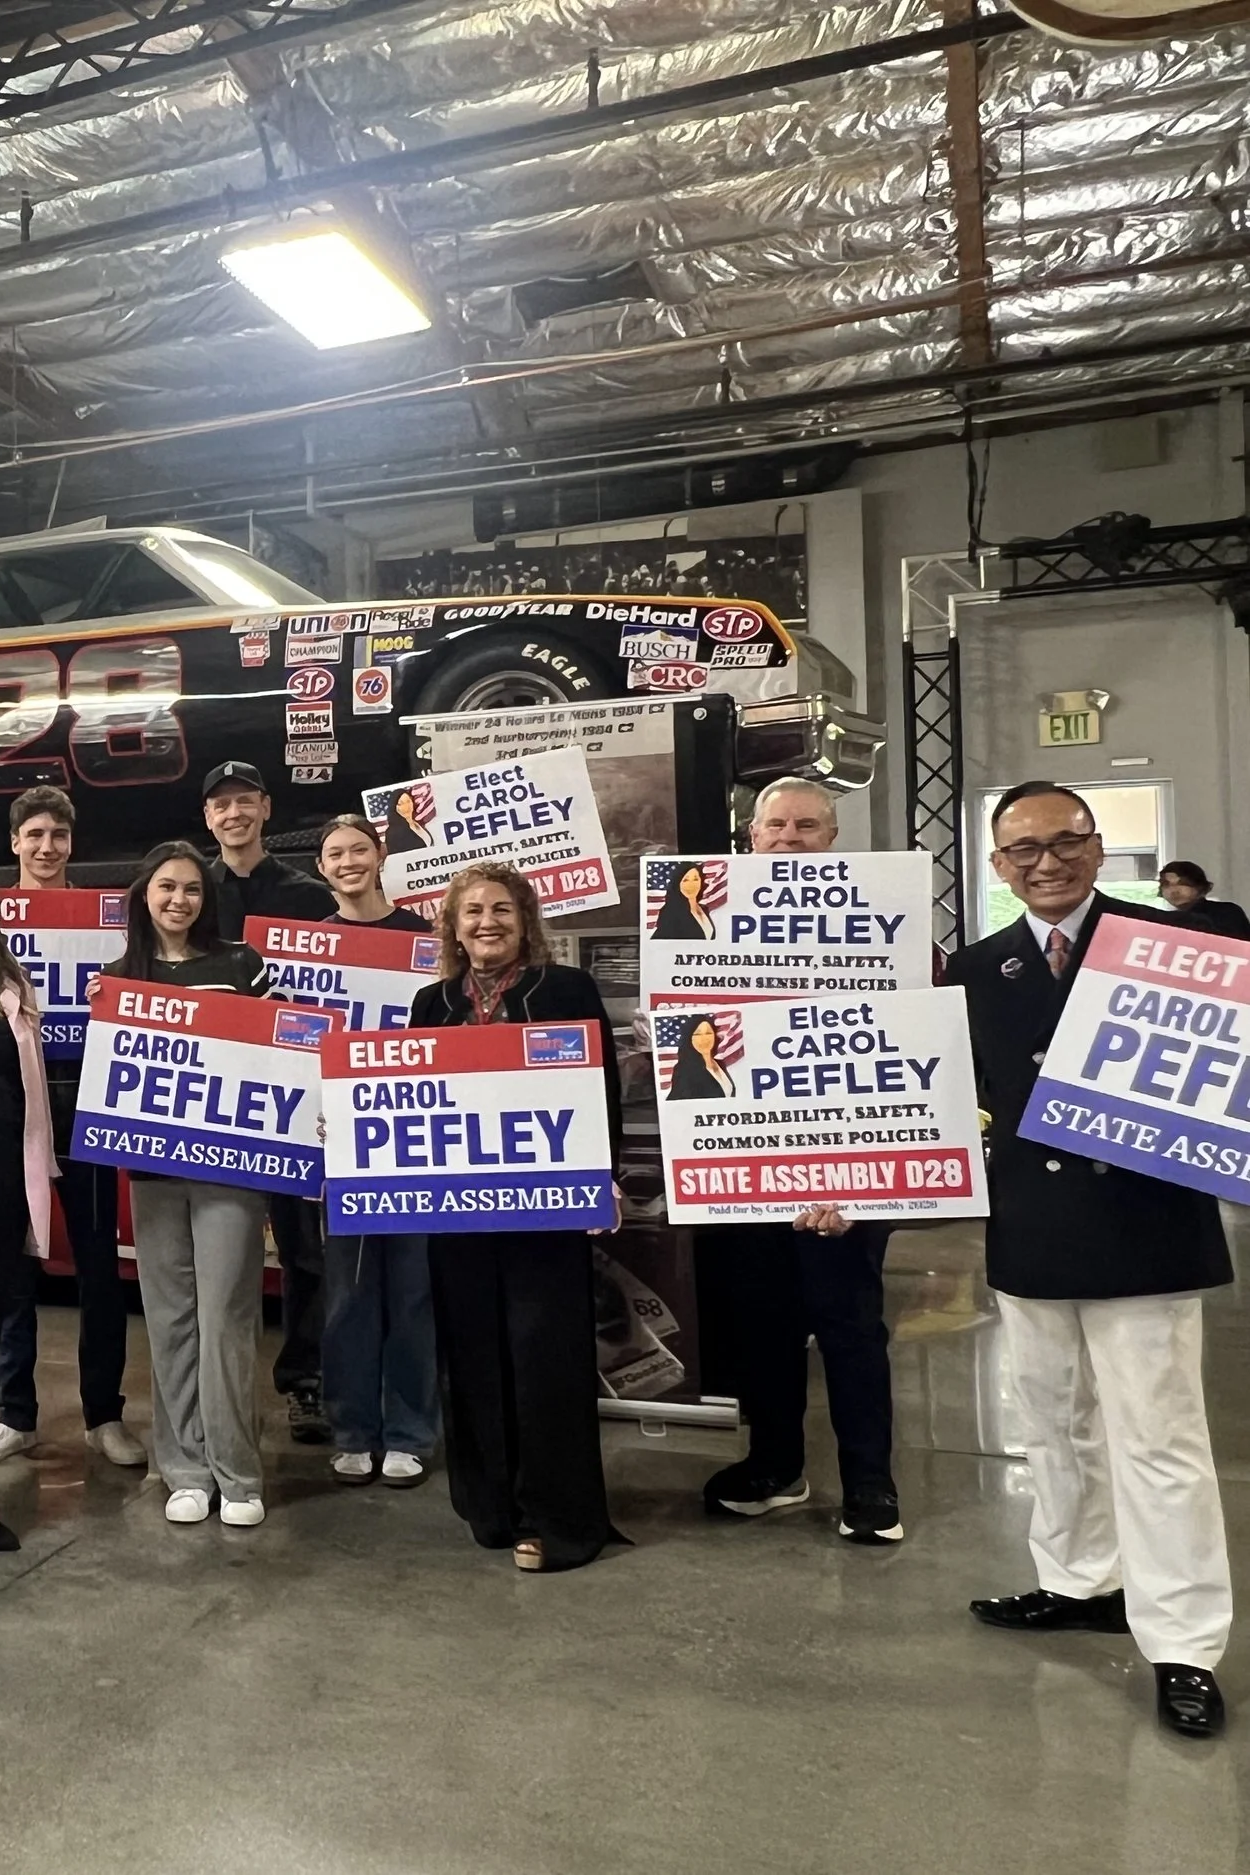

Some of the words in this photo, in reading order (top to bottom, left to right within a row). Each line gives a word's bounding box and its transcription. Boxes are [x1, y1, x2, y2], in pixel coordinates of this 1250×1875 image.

[444, 603, 574, 620] GOODYEAR
[586, 603, 697, 628] DieHard
[709, 611, 755, 635] STP
[290, 645, 338, 656] CHAMPION
[373, 636, 413, 652] MOOG
[622, 641, 691, 660] BUSCH
[715, 645, 768, 656] SPEED
[521, 643, 591, 691] EAGLE
[711, 657, 746, 665] PRO
[293, 671, 327, 694] STP
[360, 676, 383, 696] 76
[650, 666, 707, 687] CRC
[290, 713, 330, 727] Holley
[1050, 713, 1089, 742] EXIT
[464, 765, 525, 791] Elect
[455, 781, 545, 814] CAROL
[443, 796, 574, 845] PEFLEY
[406, 841, 519, 873] AFFORDABILITY,
[519, 830, 575, 849] SAFETY,
[407, 872, 451, 890] COMM
[518, 846, 582, 869] POLICIES
[559, 866, 601, 893] D28
[771, 860, 849, 882] Elect
[752, 886, 869, 908] CAROL
[266, 927, 342, 957] ELECT
[731, 914, 906, 944] PEFLEY
[674, 955, 819, 970] AFFORDABILITY,
[822, 955, 895, 970] SAFETY,
[1123, 936, 1250, 987] ELECT
[267, 963, 348, 994] CAROL
[671, 976, 751, 988] COMMON
[755, 977, 809, 989] SENSE
[813, 977, 898, 991] POLICIES
[118, 991, 199, 1026] ELECT
[789, 1002, 874, 1031] Elect
[1108, 984, 1241, 1045] CAROL
[113, 1030, 205, 1068] CAROL
[349, 1038, 437, 1068] ELECT
[771, 1029, 900, 1060] CAROL
[751, 1056, 941, 1099] PEFLEY
[104, 1060, 306, 1135] PEFLEY
[352, 1080, 456, 1112] CAROL
[694, 1108, 851, 1127] AFFORDABILITY,
[855, 1103, 935, 1121] SAFETY,
[1041, 1099, 1162, 1153] STATE
[84, 1126, 167, 1158] STATE
[170, 1140, 315, 1181] ASSEMBLY
[354, 1109, 575, 1169] PEFLEY
[693, 1133, 780, 1151] COMMON
[785, 1132, 844, 1147] SENSE
[849, 1127, 941, 1145] POLICIES
[679, 1166, 753, 1195] STATE
[760, 1160, 897, 1193] ASSEMBLY
[905, 1158, 964, 1189] D28
[342, 1191, 433, 1215] STATE
[438, 1185, 601, 1212] ASSEMBLY
[634, 1298, 663, 1317] 68
